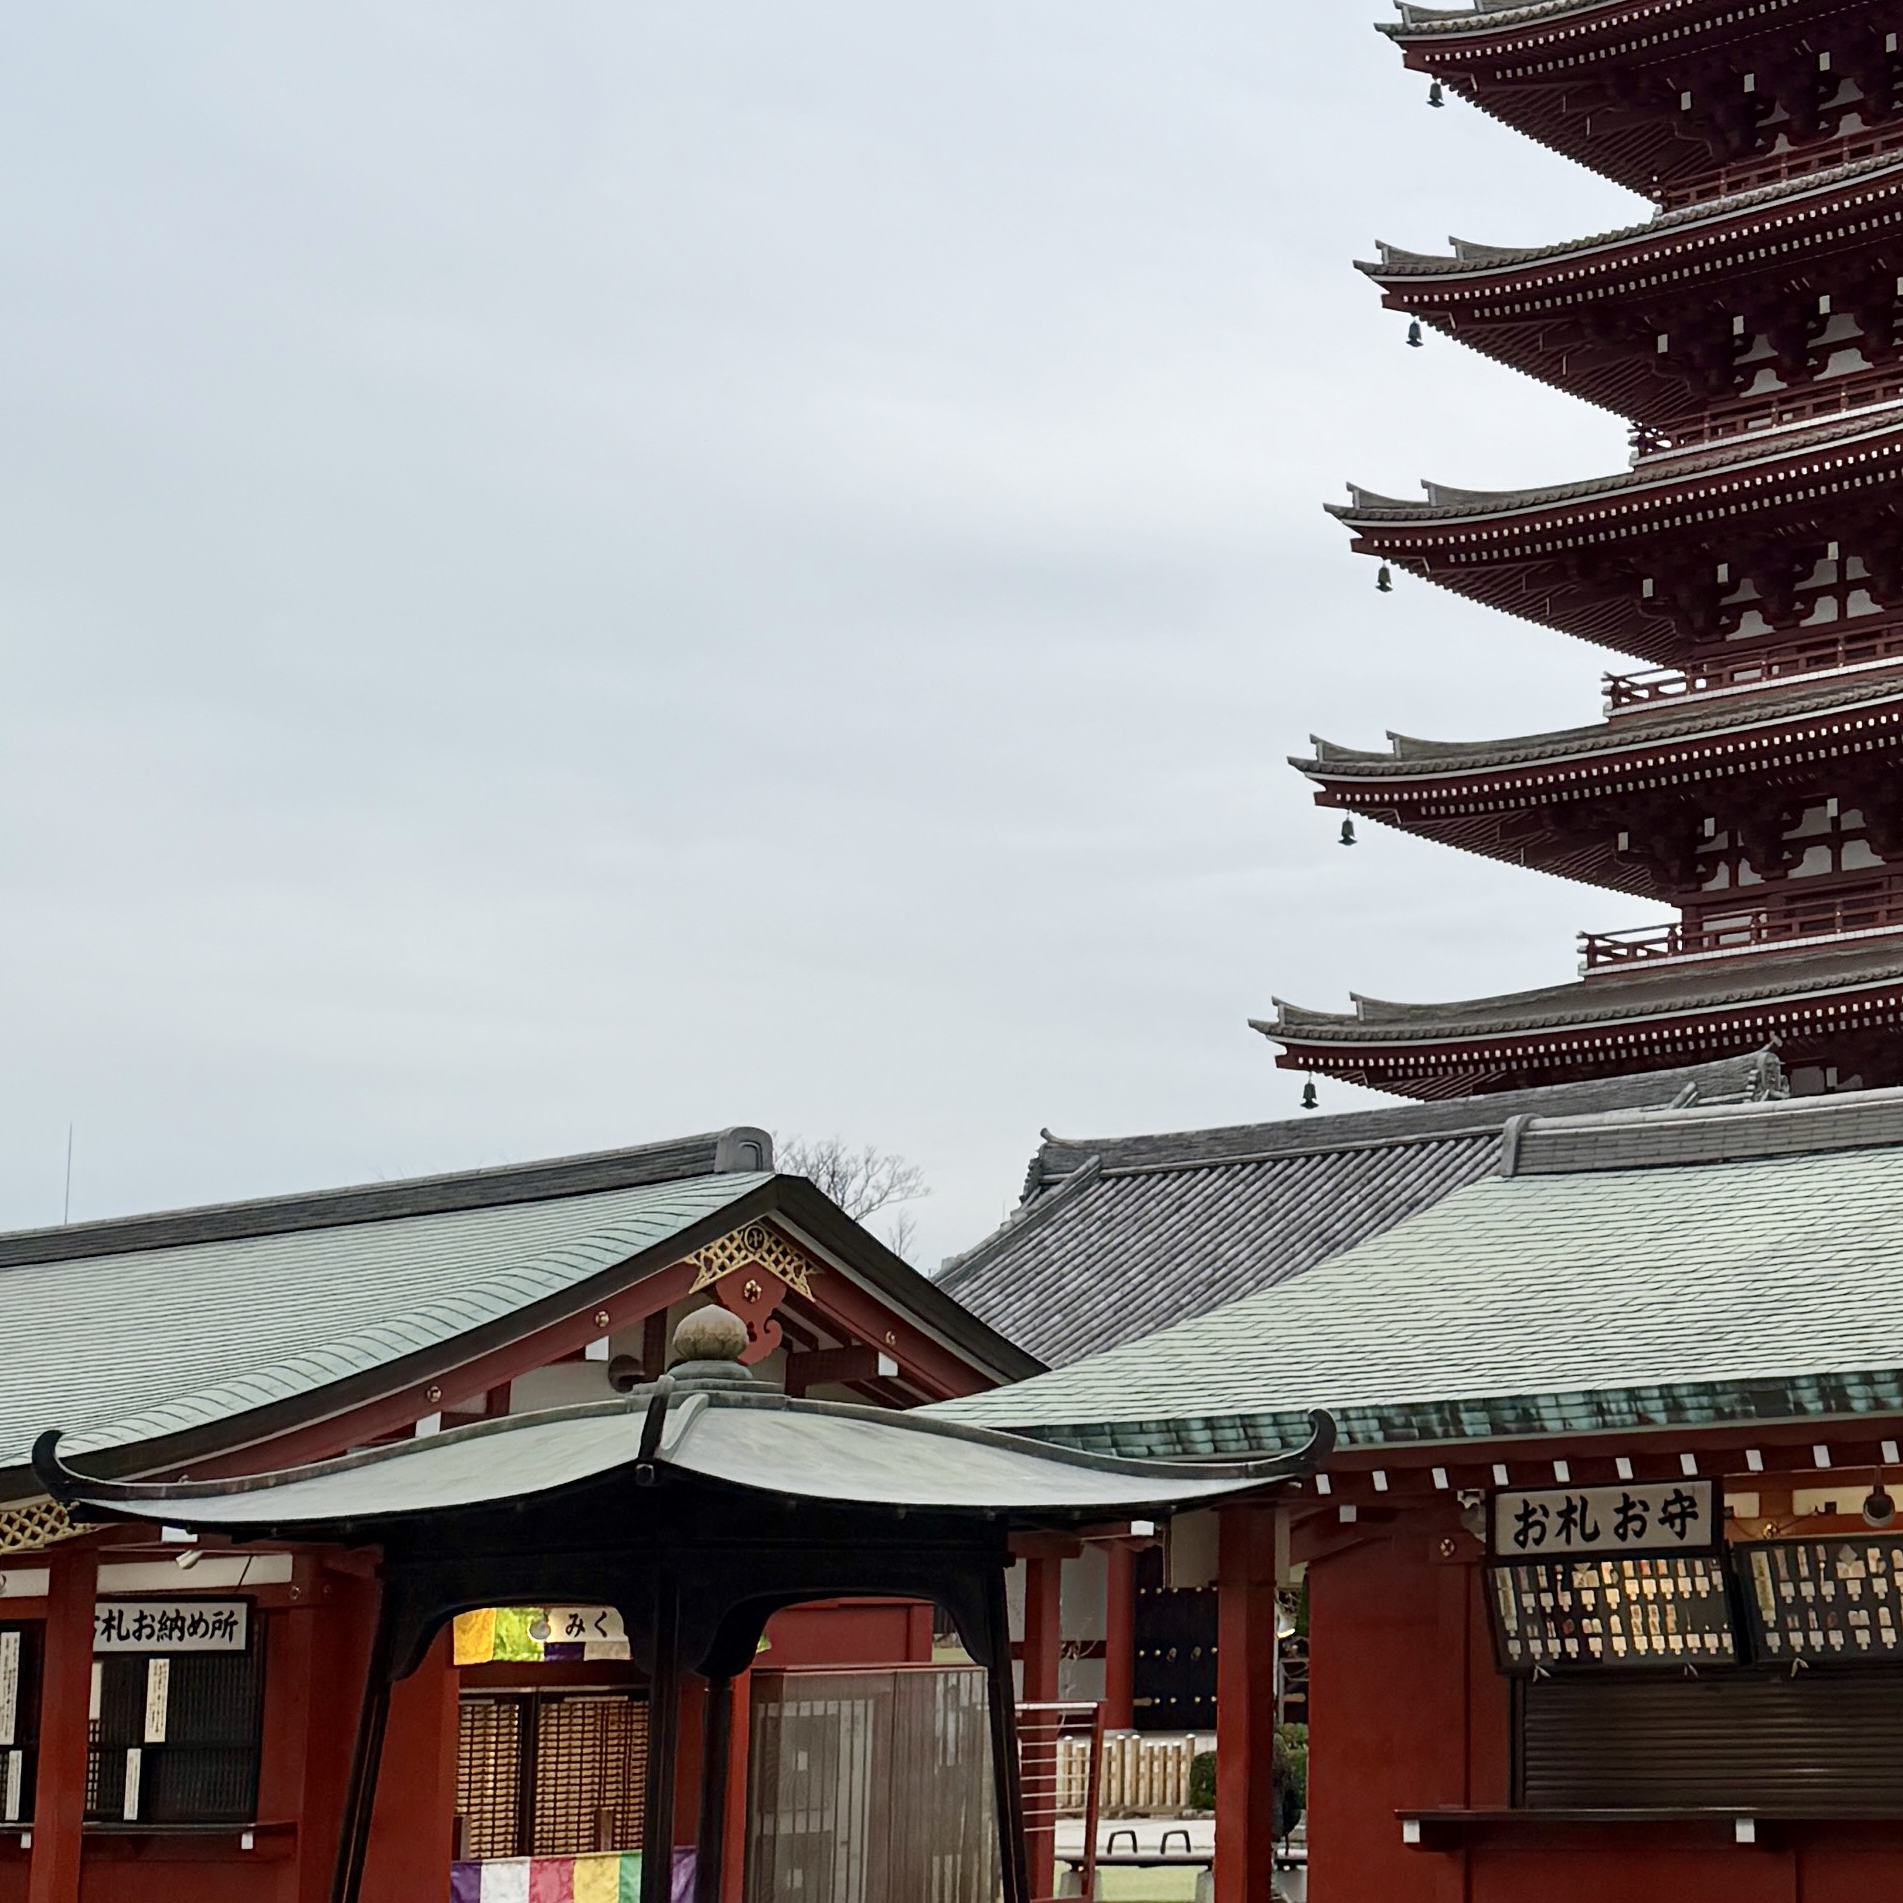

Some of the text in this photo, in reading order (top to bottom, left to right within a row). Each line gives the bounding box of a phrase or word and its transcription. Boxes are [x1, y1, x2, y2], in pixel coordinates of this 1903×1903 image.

[1513, 1488, 1699, 1549] お札お守
[95, 1608, 239, 1643] 札お納め所
